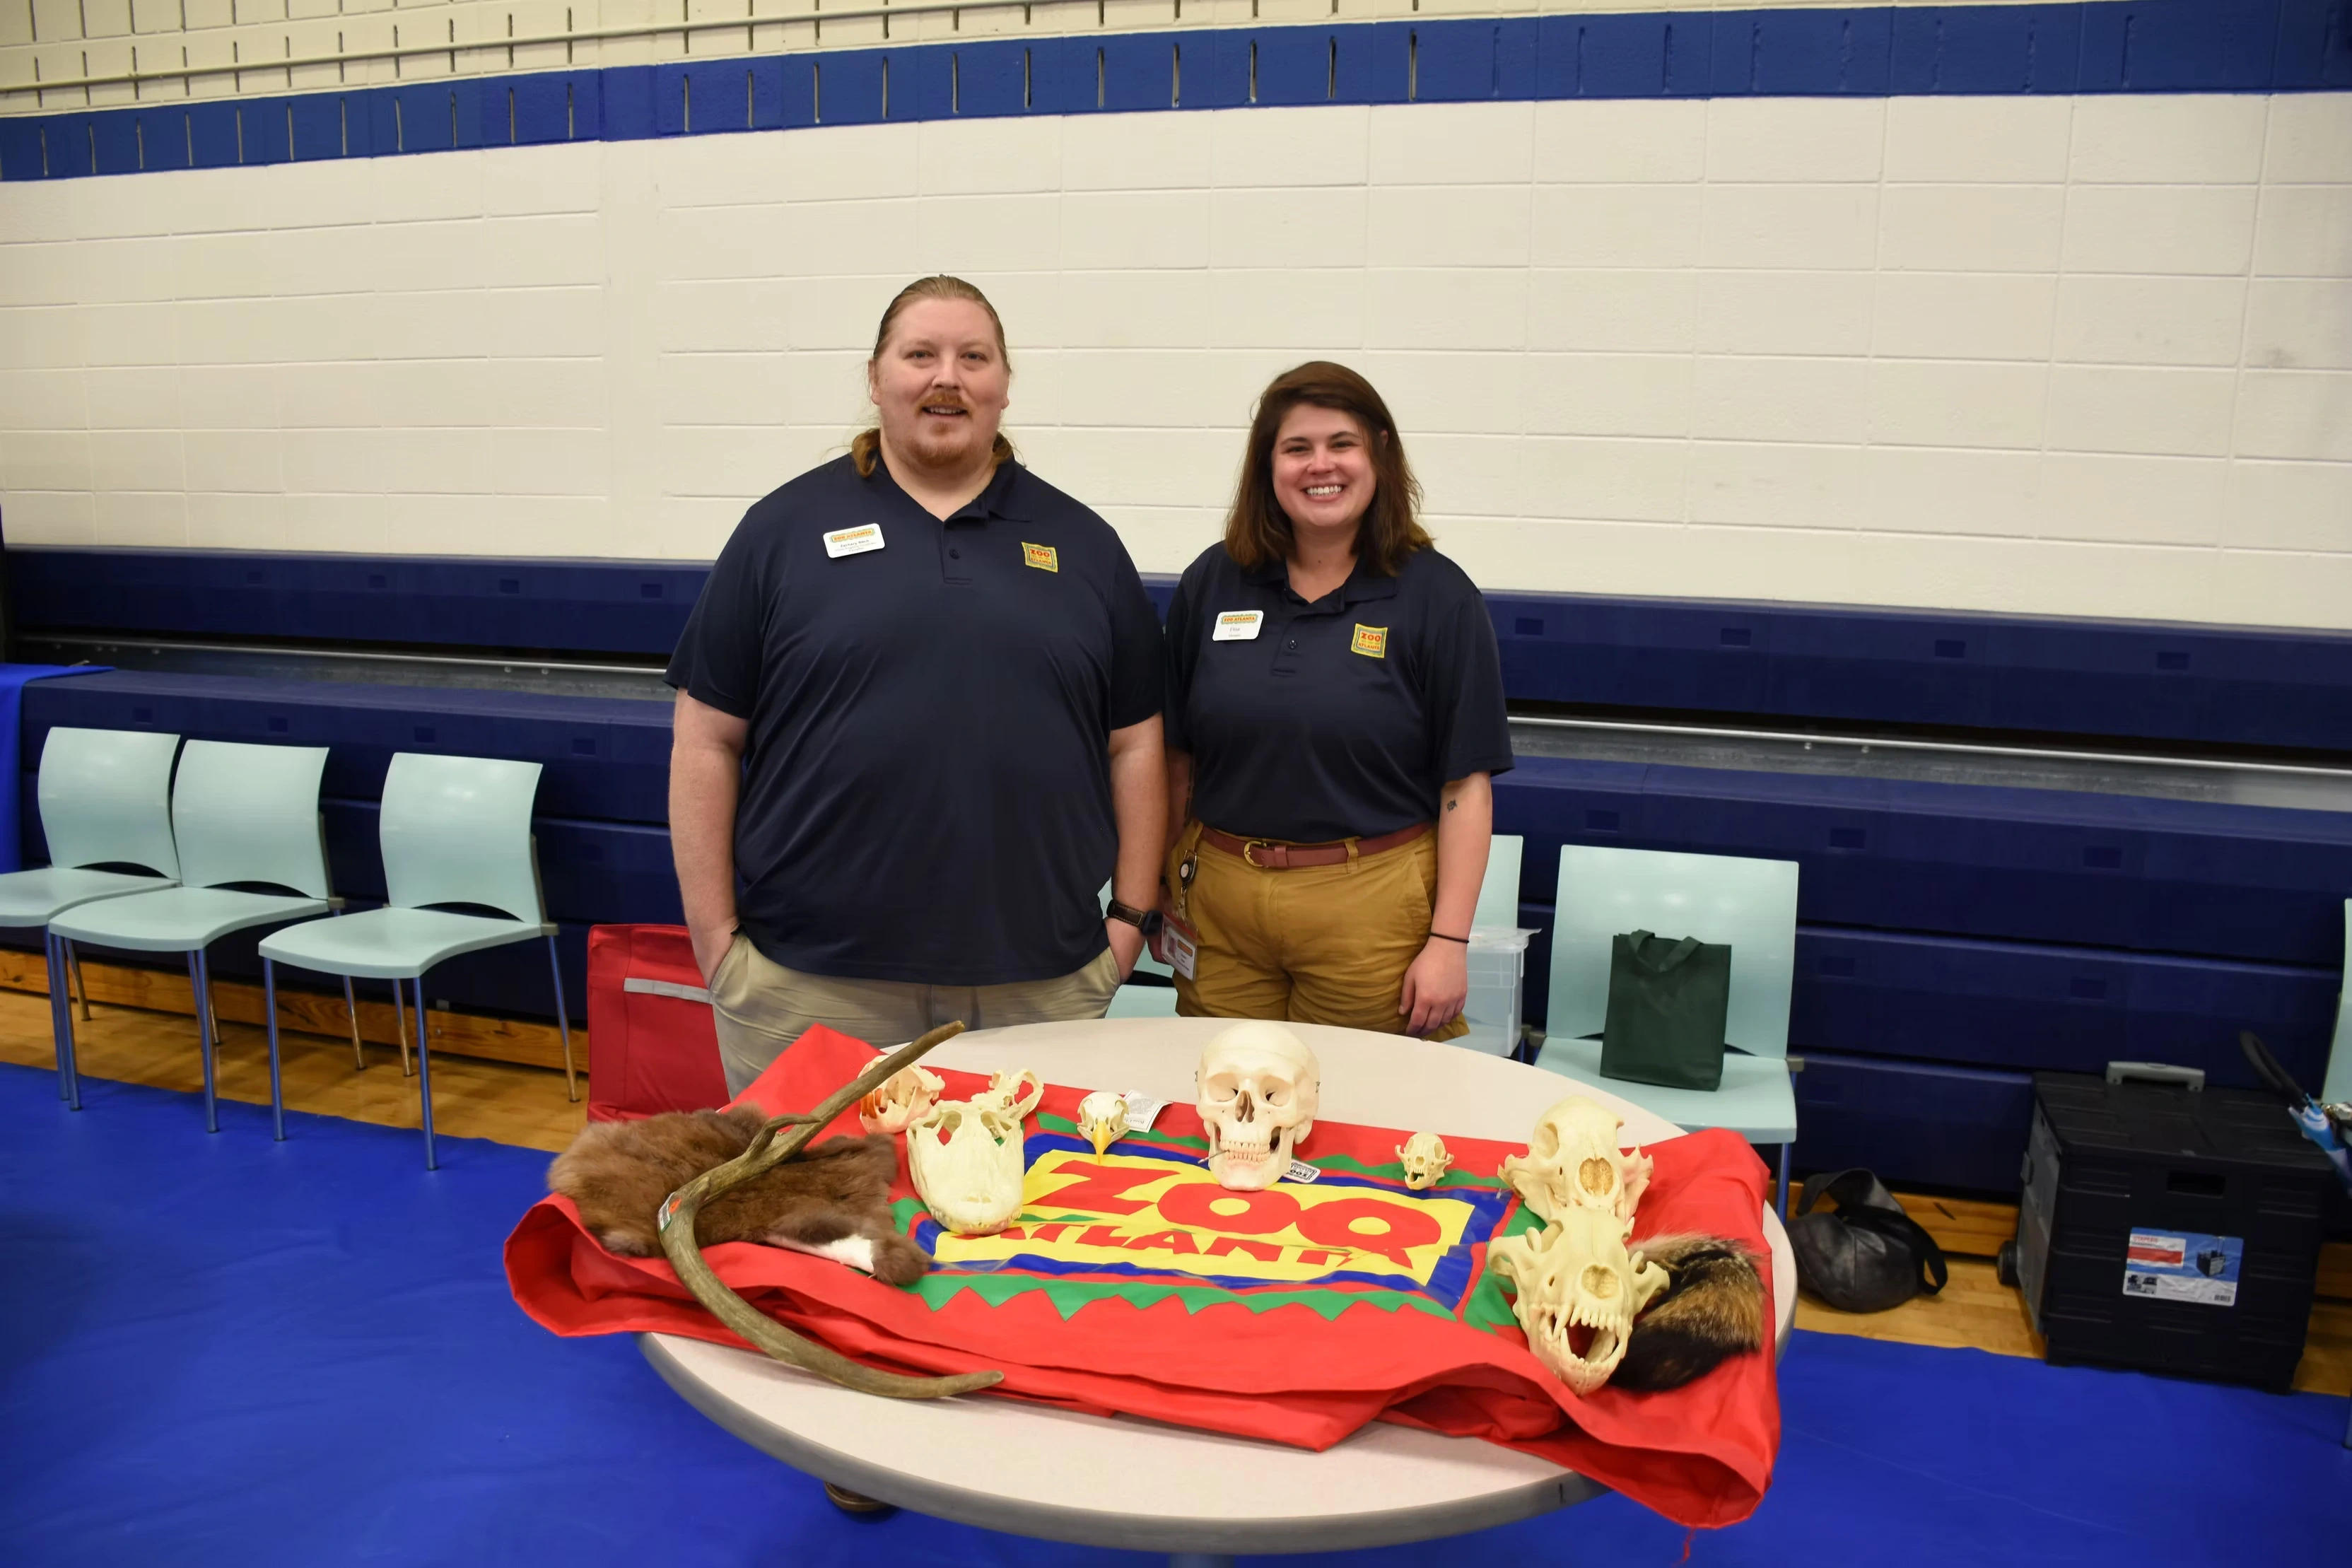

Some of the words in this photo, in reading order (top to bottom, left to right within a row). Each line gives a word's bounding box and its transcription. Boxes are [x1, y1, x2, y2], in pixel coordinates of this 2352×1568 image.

[1029, 549, 1050, 557] ZOO
[1030, 557, 1052, 566] ATLANTA
[1361, 632, 1381, 642] ZOO
[1357, 642, 1380, 650] ATLANTA
[1024, 1159, 1441, 1248] ZOO
